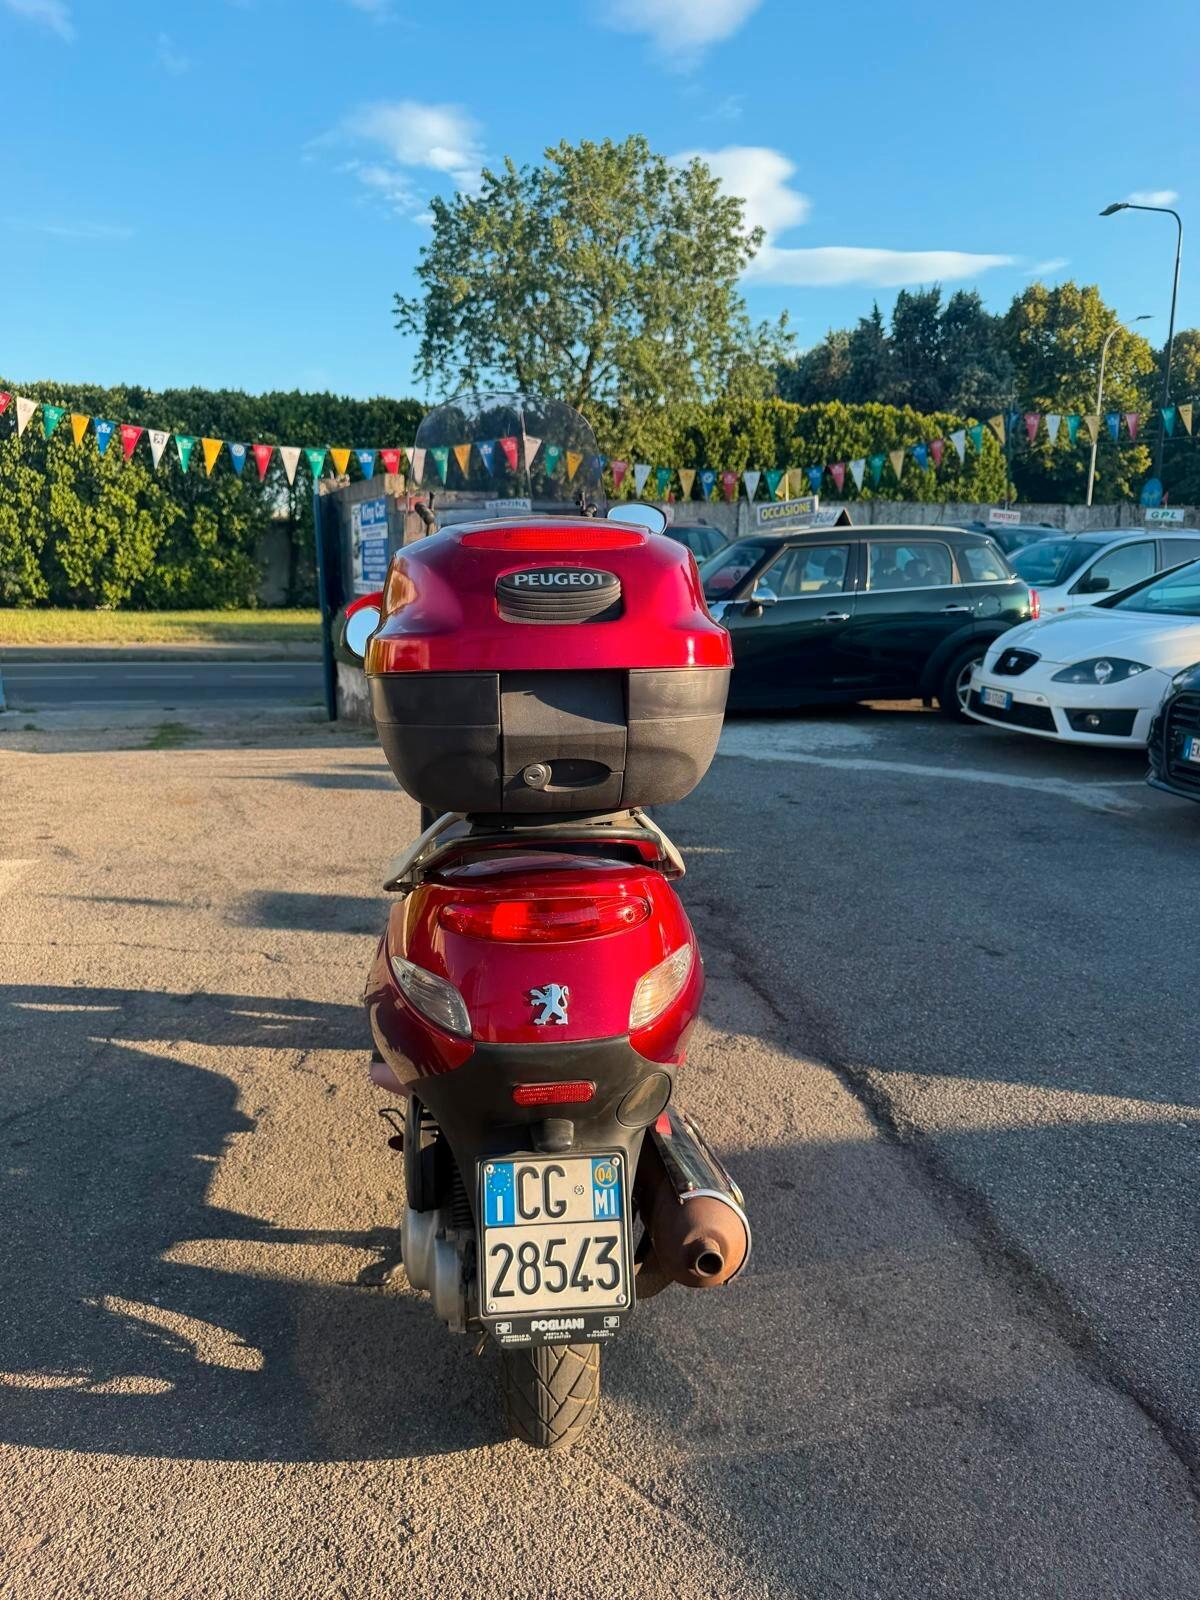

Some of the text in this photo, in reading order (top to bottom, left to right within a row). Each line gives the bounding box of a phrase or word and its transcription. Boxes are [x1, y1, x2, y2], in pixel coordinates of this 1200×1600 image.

[761, 502, 811, 520] OCCASIONE
[1151, 511, 1177, 519] GPL
[514, 573, 605, 586] PEUGEOT
[598, 1167, 613, 1183] 04
[516, 1164, 568, 1220] CG
[594, 1188, 616, 1216] MI
[490, 1236, 620, 1297] 28543
[531, 1318, 584, 1331] POGLIANI
